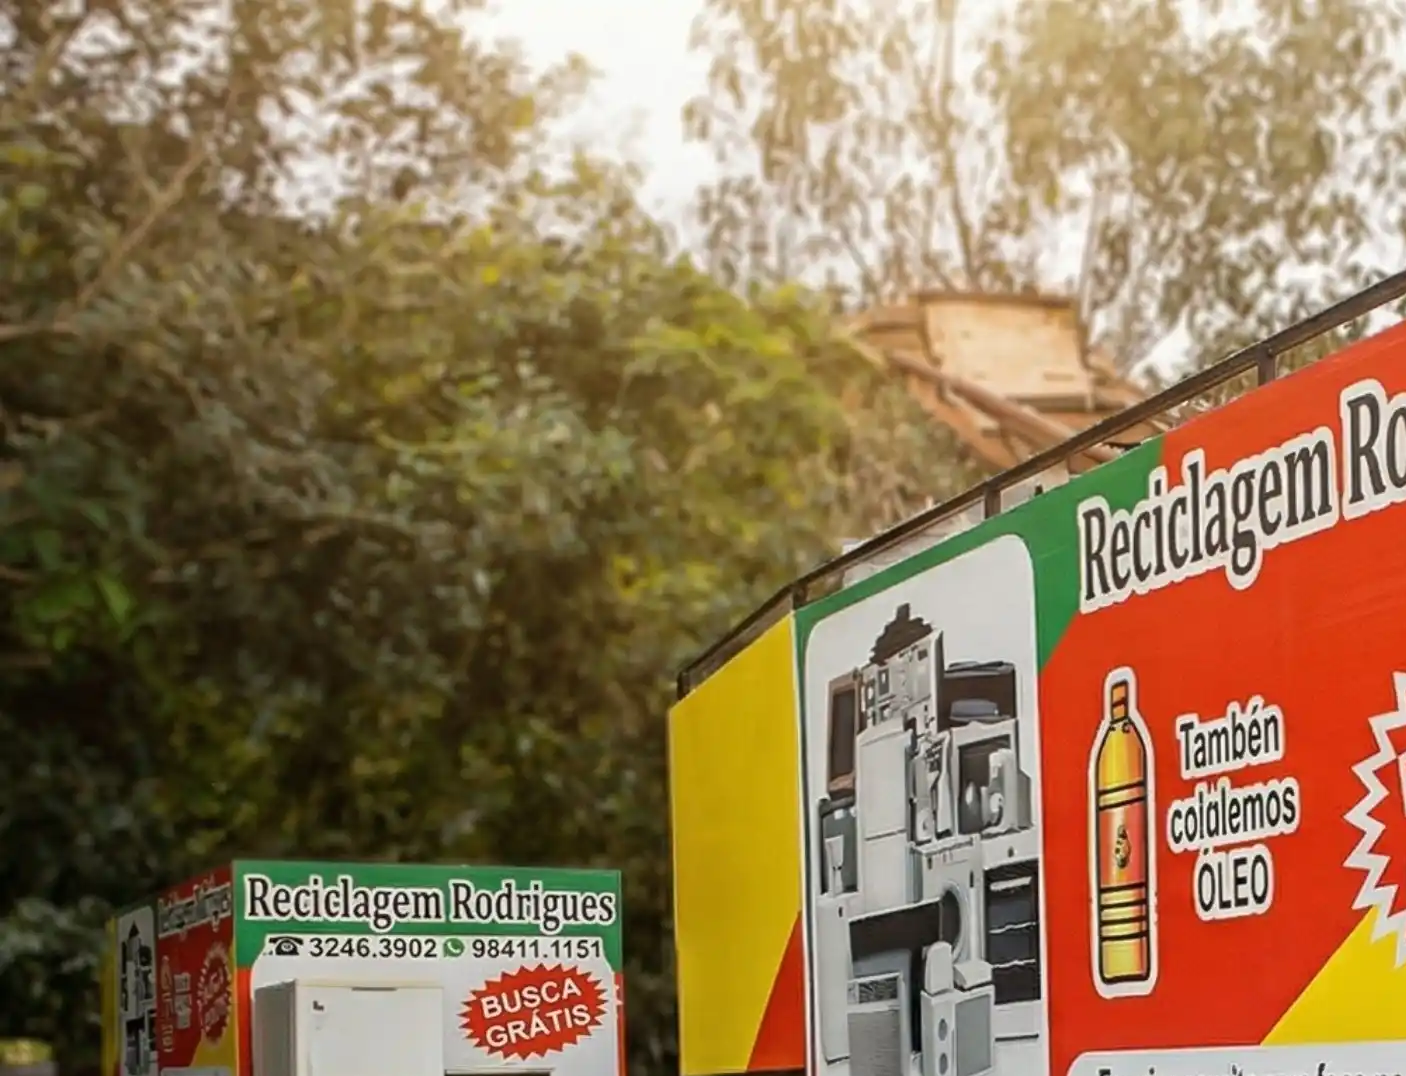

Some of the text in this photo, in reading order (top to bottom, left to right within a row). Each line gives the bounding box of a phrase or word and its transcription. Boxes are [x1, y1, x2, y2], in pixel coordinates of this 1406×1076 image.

[1081, 434, 1333, 601] Reciclagem
[247, 877, 441, 930] Reciclagem
[451, 881, 614, 931] Rodrigues
[309, 937, 602, 959] 3246.3902 98411.1151
[480, 977, 582, 1019] BUSCA
[485, 1003, 592, 1048] GRÁTIS
